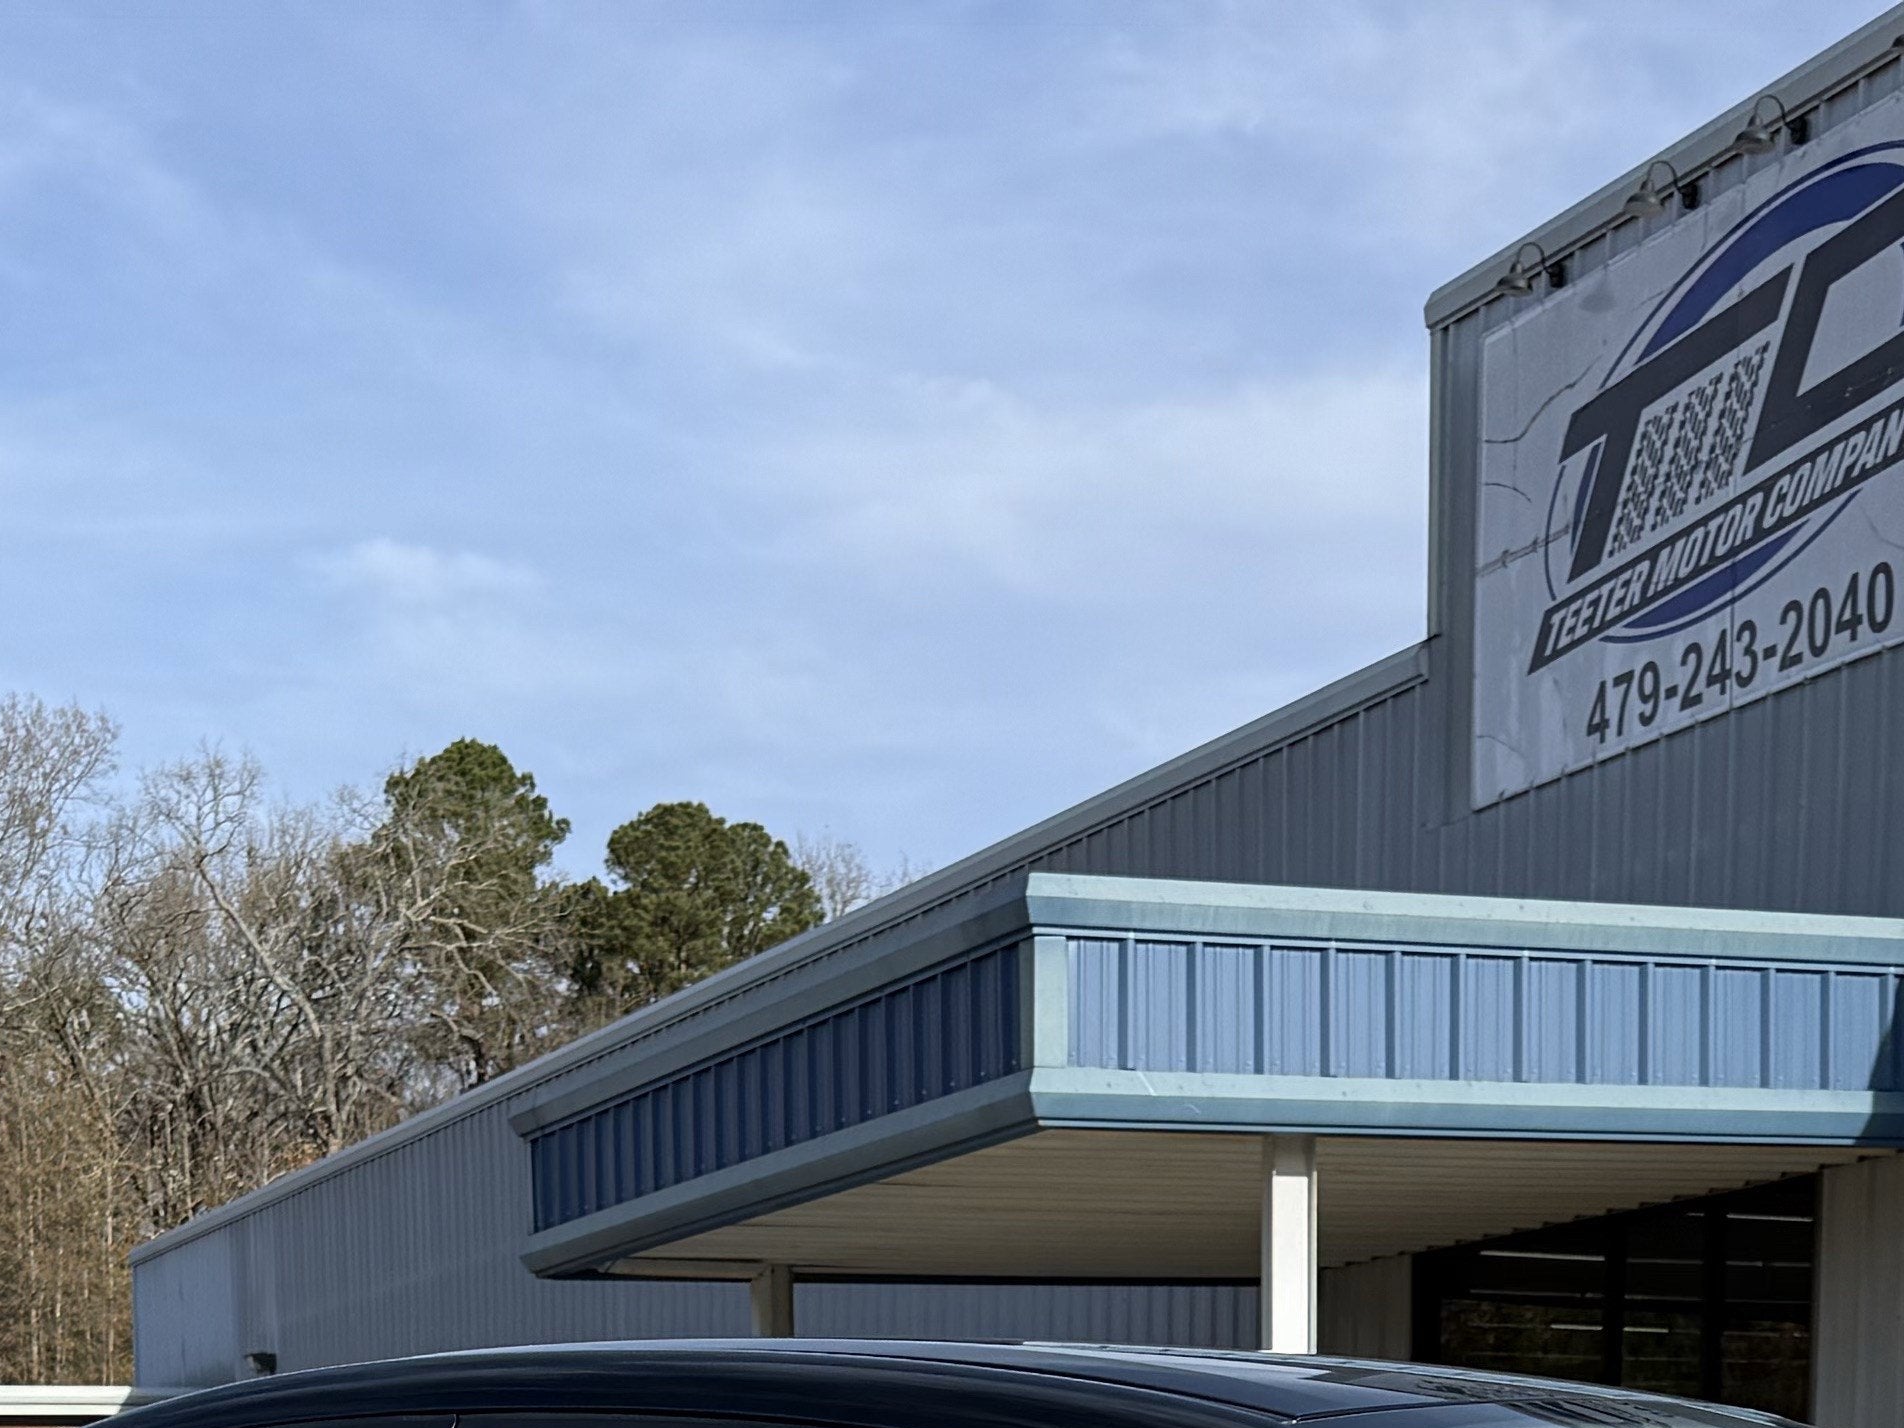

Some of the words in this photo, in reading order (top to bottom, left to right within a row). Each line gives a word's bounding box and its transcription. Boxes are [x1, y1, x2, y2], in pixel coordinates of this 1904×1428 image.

[1545, 557, 1653, 655] TEETER
[1648, 497, 1759, 595] MOTOR
[1585, 561, 1895, 744] 479-243-2040
